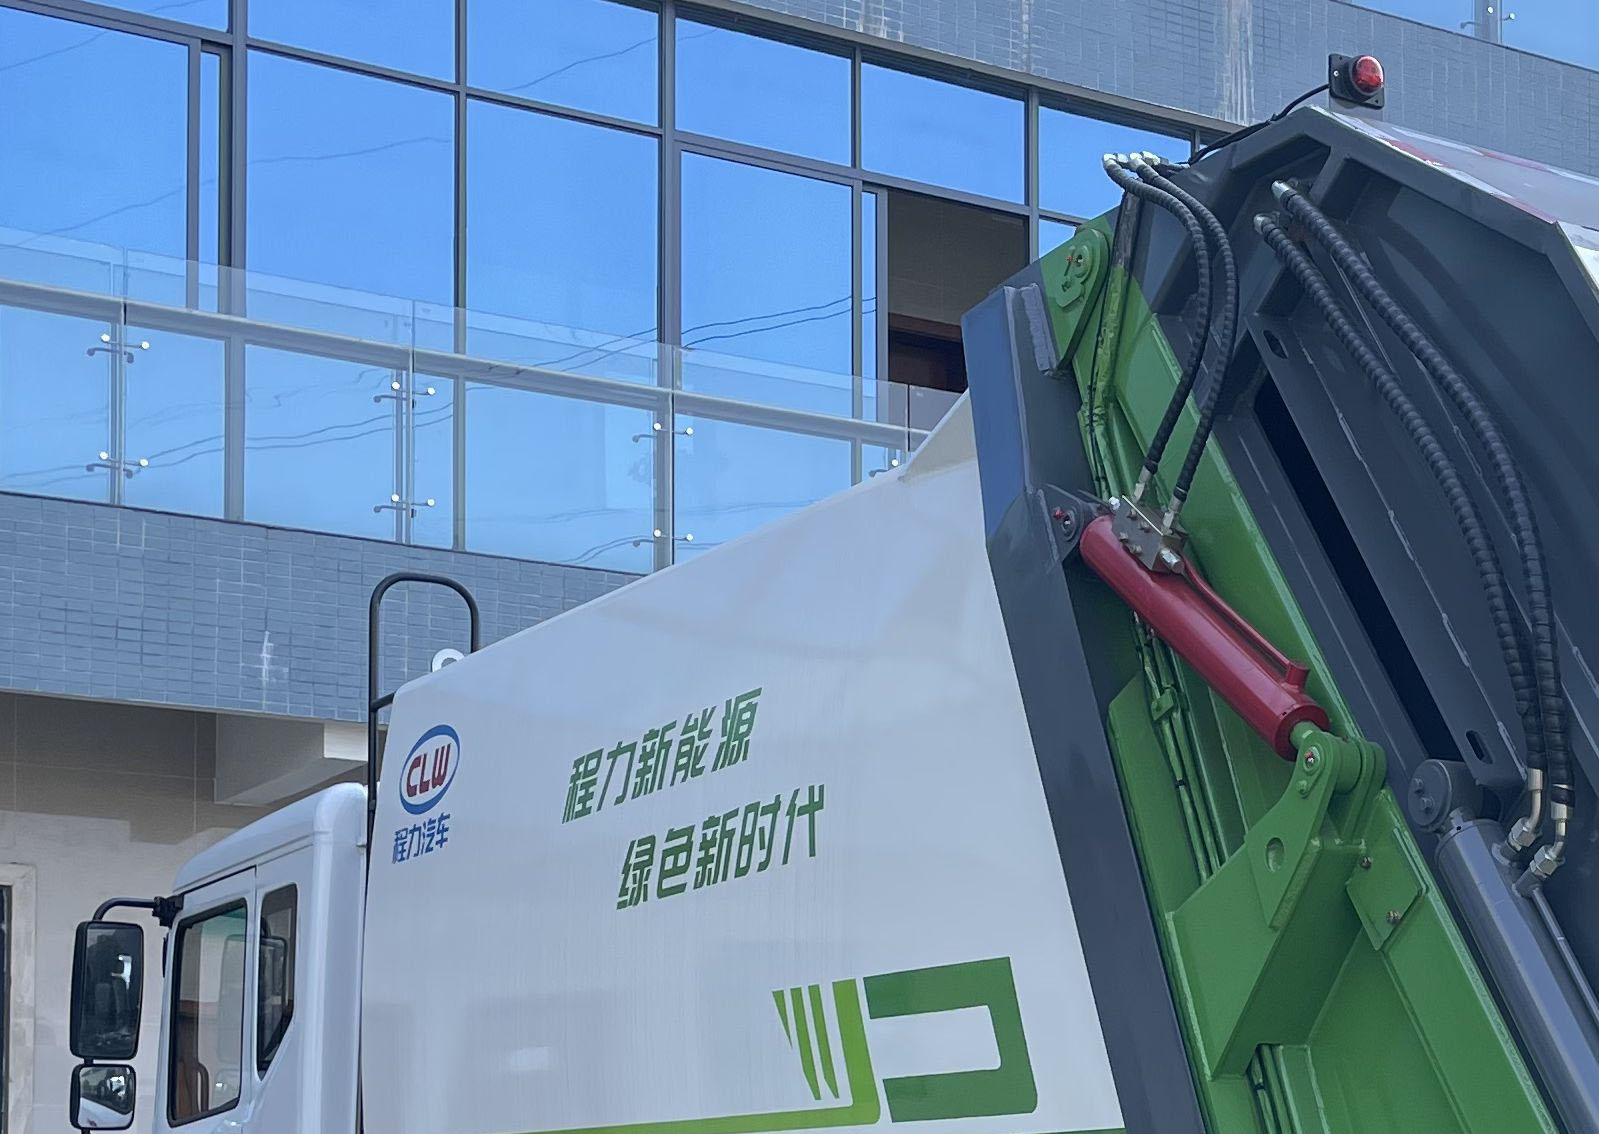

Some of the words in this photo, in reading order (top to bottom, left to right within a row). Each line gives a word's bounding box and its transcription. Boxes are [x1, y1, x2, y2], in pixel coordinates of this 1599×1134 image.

[406, 743, 451, 797] CLW
[562, 687, 762, 824] 程力新能源
[392, 812, 450, 864] 程力汽车
[616, 784, 824, 910] 绿色新时代
